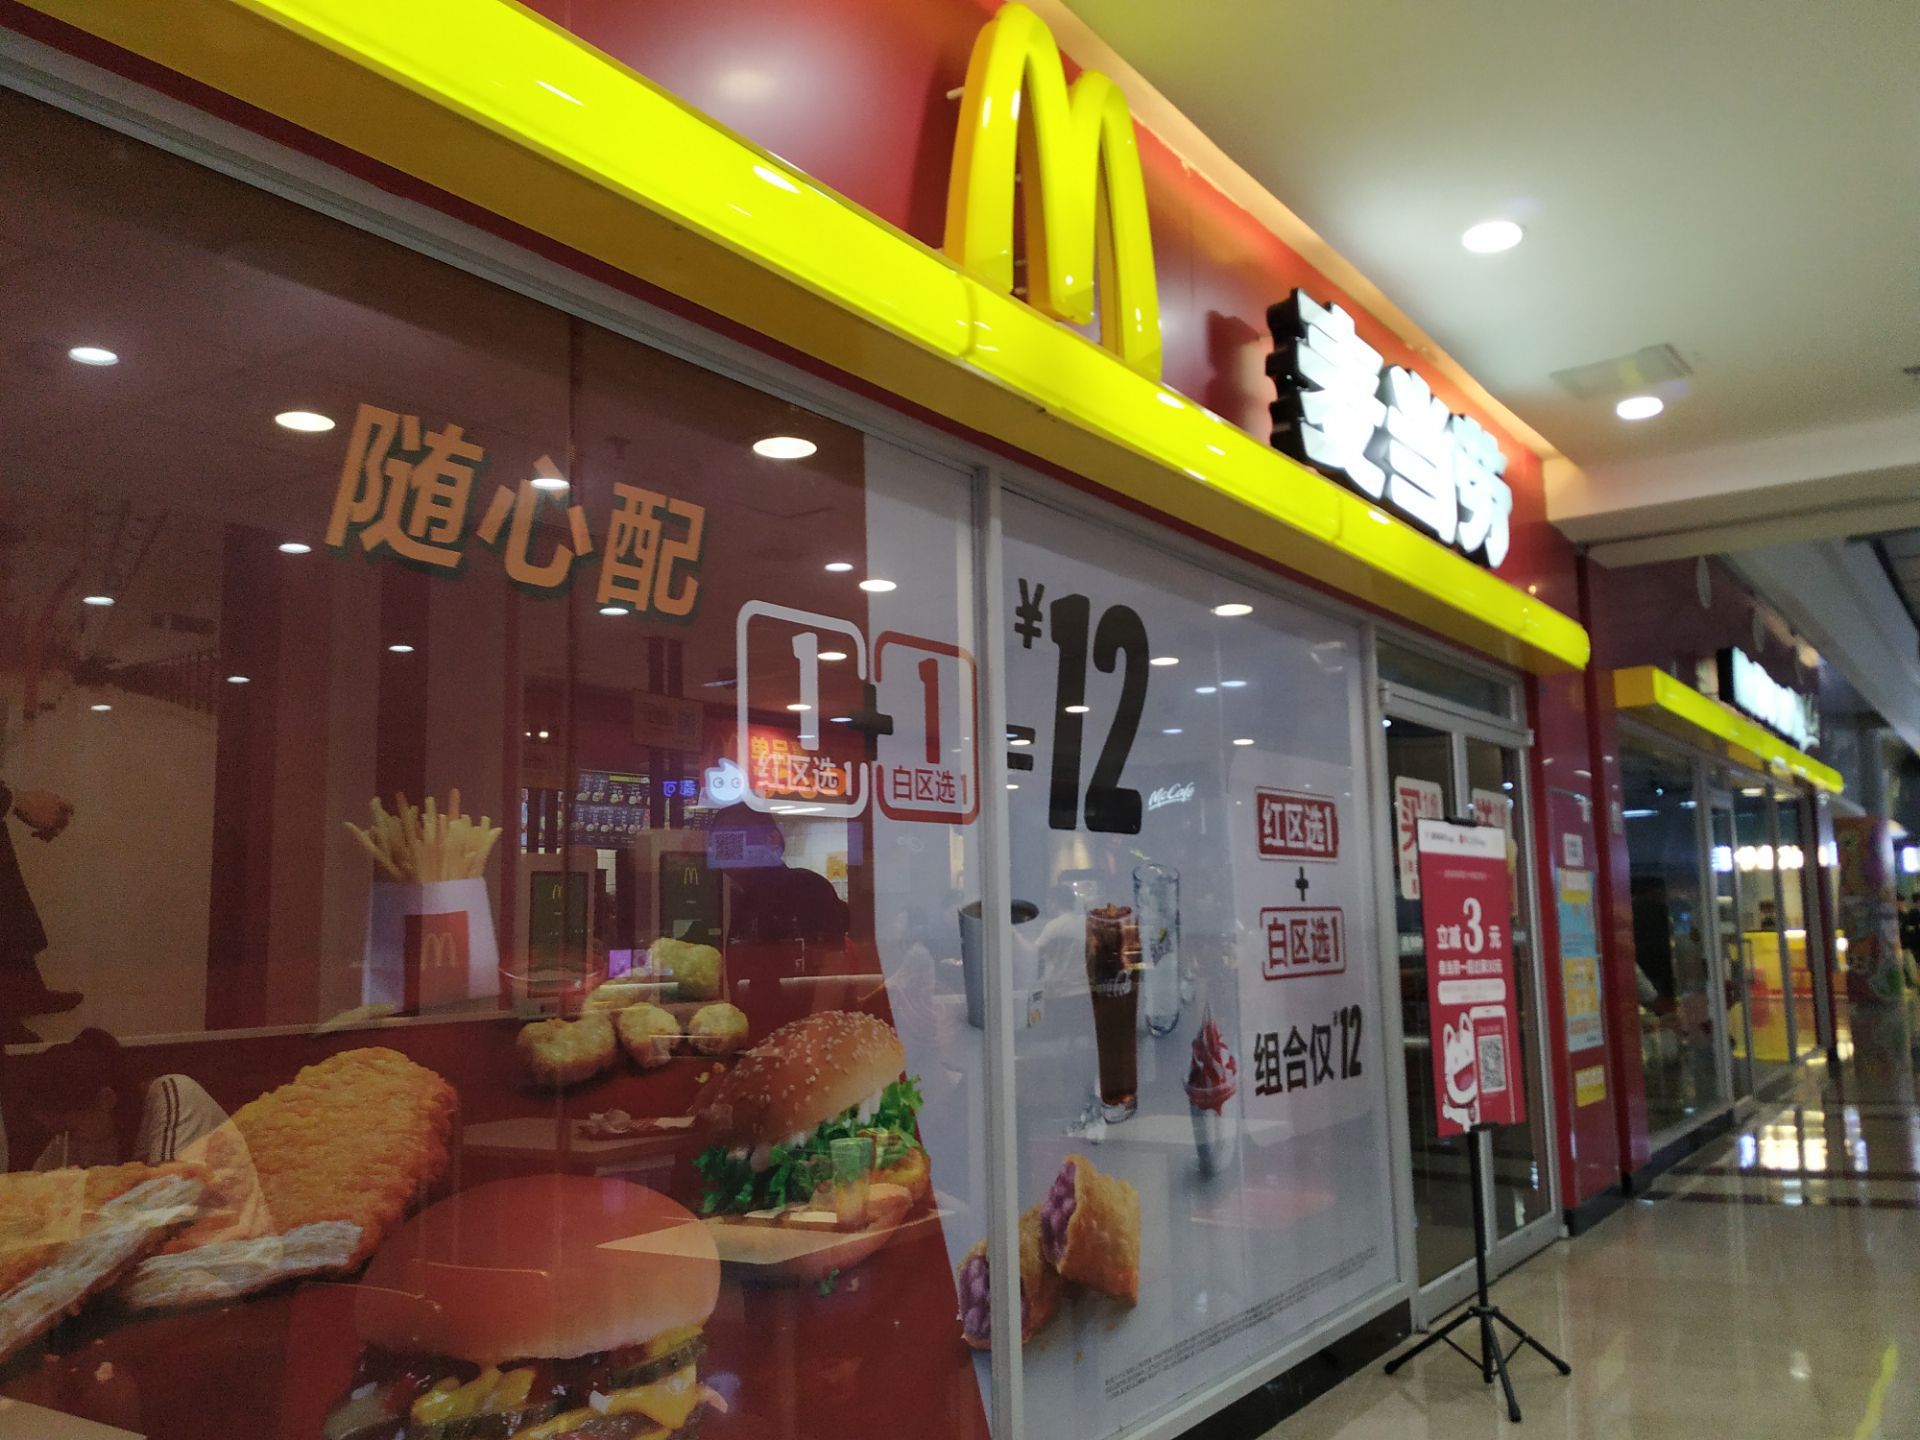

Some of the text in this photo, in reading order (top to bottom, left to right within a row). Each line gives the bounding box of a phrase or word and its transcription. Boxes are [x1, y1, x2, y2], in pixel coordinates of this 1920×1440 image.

[1290, 286, 1513, 571] 麦当劳
[326, 403, 707, 618] 随心配
[756, 753, 853, 797] 红区选1
[893, 766, 968, 805] 白区选1
[1263, 798, 1334, 852] 红区选1
[1267, 916, 1340, 969] 白区选1
